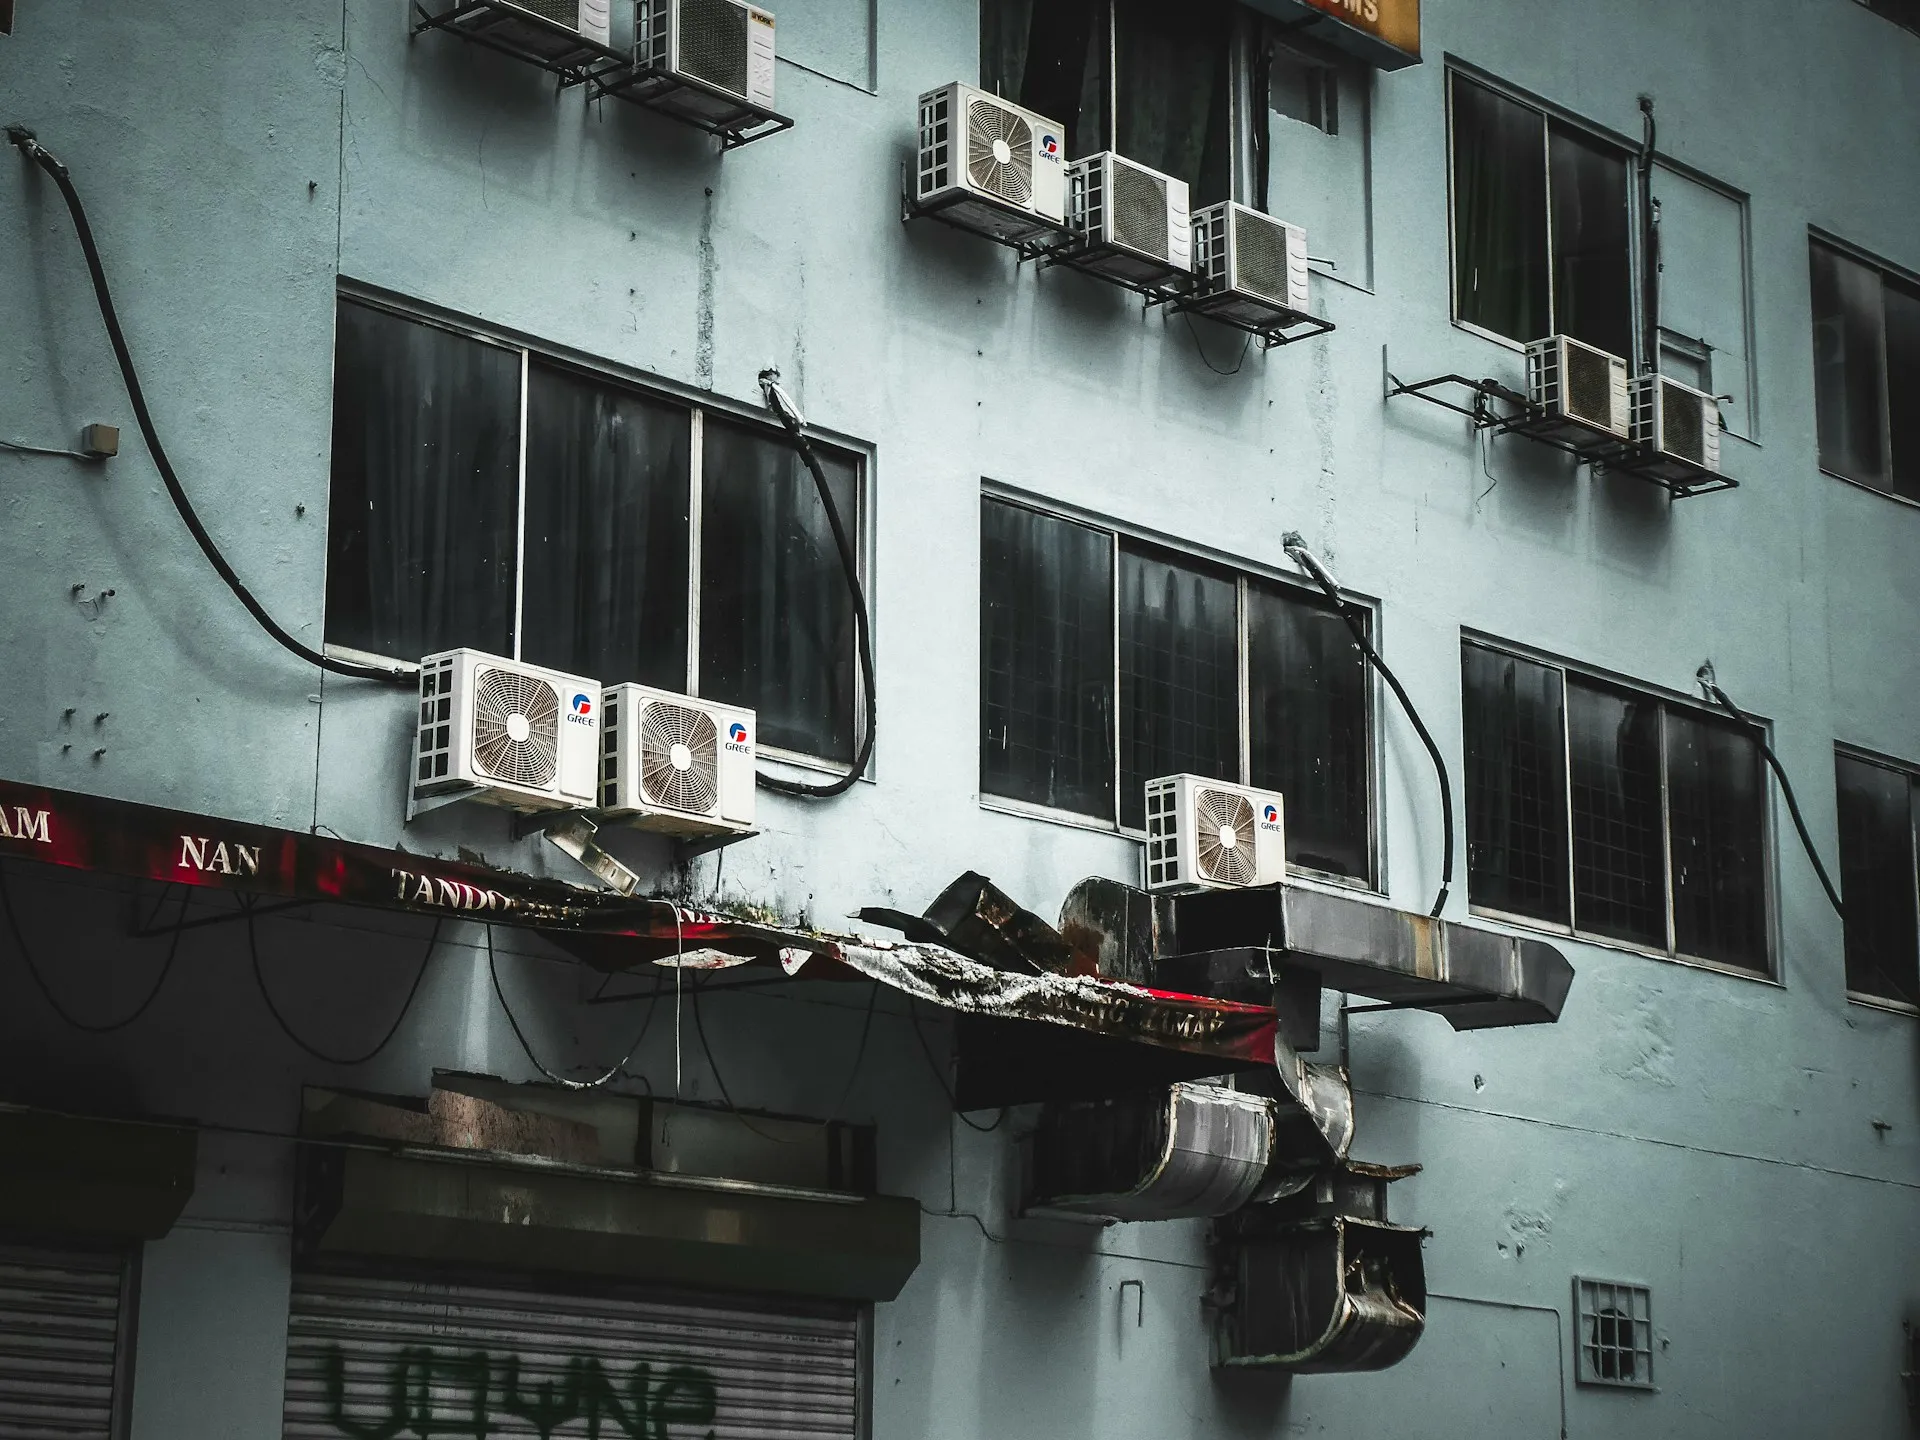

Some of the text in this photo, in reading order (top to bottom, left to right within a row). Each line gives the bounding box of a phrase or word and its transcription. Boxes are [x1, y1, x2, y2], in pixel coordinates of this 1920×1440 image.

[1330, 0, 1379, 22] MS
[1038, 150, 1060, 164] GREE
[566, 713, 595, 728] GREE
[725, 741, 751, 754] GREE
[1261, 822, 1280, 832] GREE
[178, 835, 262, 876] NAN
